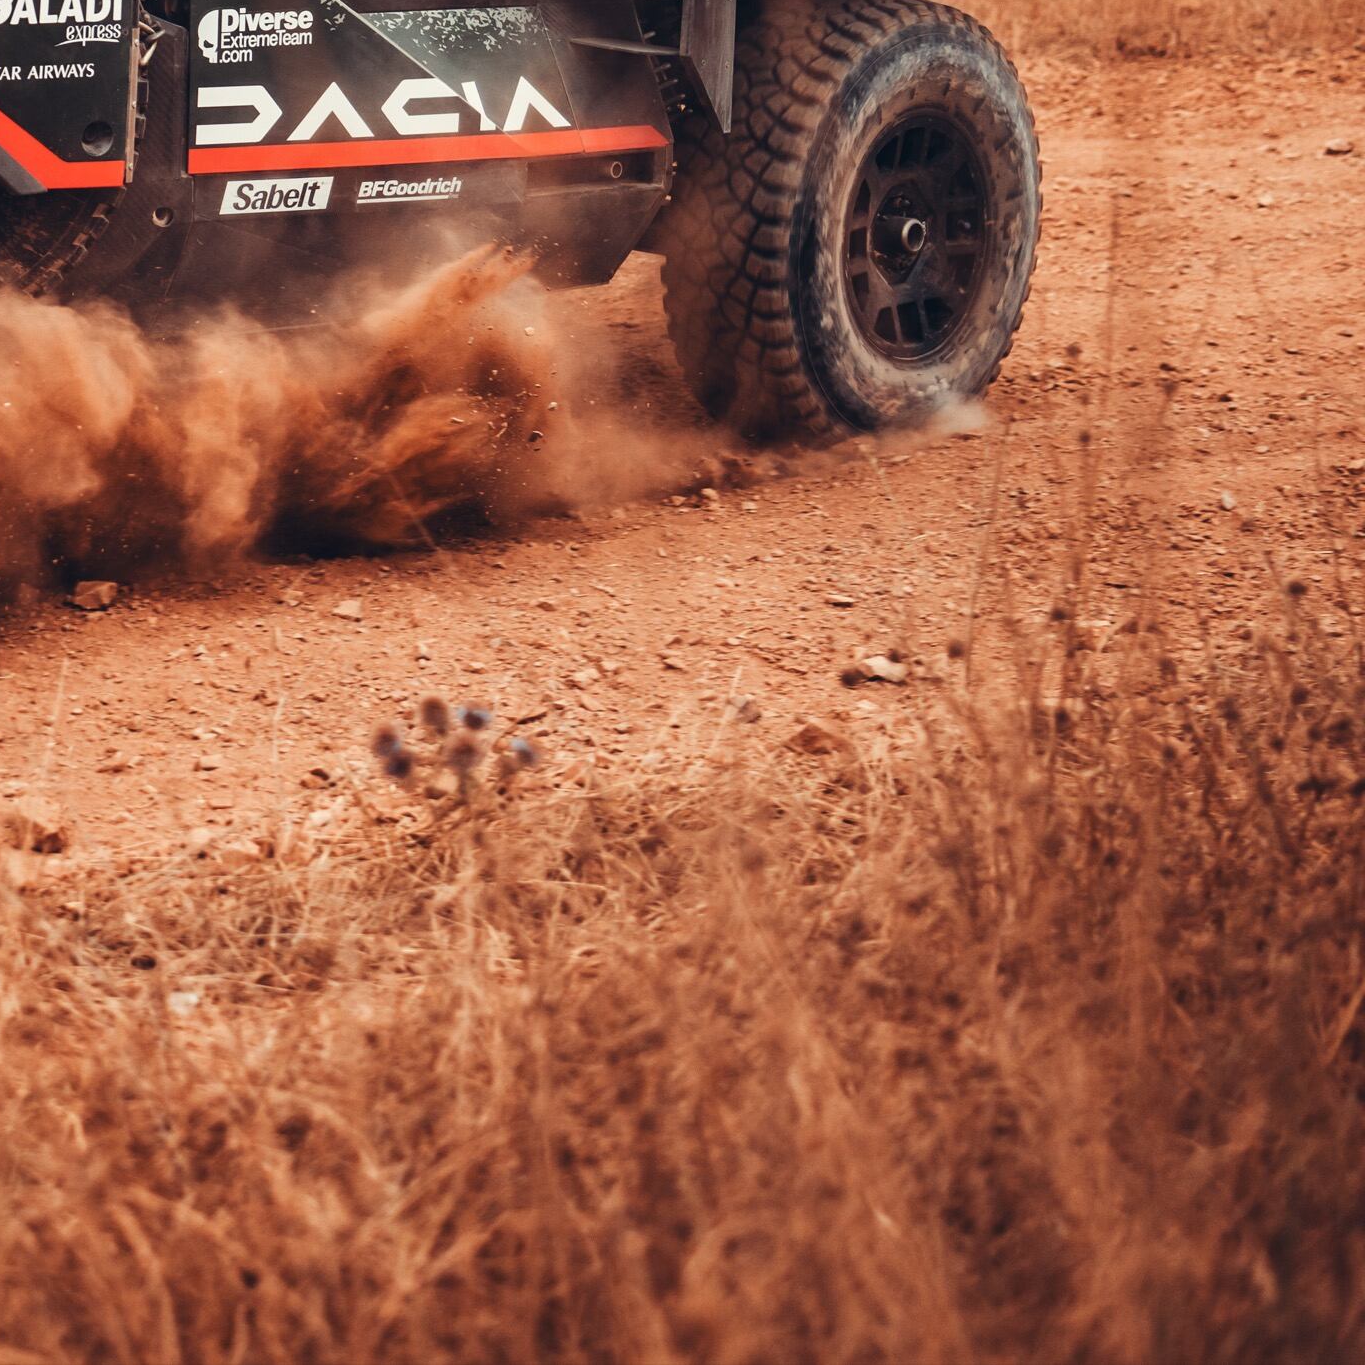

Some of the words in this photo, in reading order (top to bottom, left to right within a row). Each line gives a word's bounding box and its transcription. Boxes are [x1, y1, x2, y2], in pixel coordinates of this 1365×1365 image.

[221, 7, 314, 32] Diverse
[65, 24, 121, 46] express
[220, 30, 313, 49] ExtremeTeam
[219, 49, 253, 64] .com
[27, 63, 95, 79] AIRWAYS
[195, 77, 571, 145] DACIA
[232, 181, 322, 211] Sabelt
[358, 177, 462, 197] BFGoodrich
